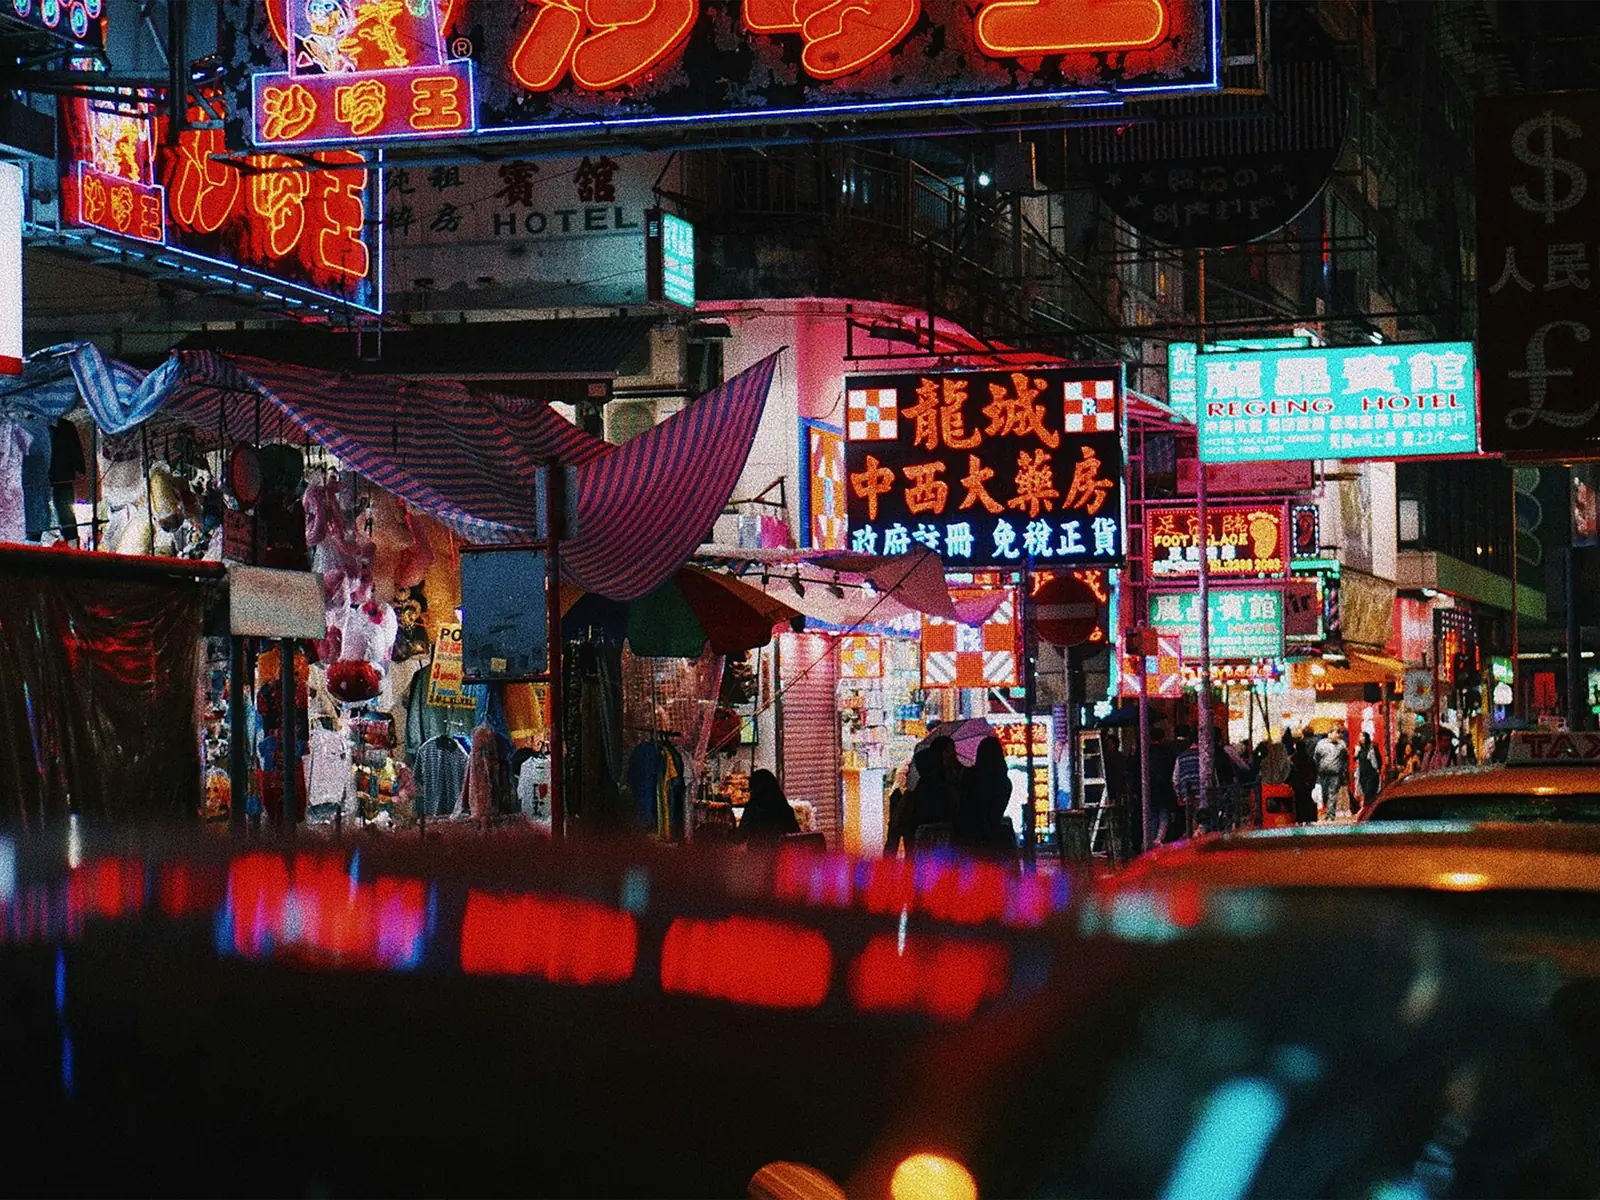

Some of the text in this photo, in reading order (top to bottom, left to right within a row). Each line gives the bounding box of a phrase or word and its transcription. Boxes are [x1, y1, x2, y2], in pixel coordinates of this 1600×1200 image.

[494, 207, 638, 239] HOTEL
[1489, 243, 1600, 294] 人民
[1204, 351, 1467, 400] 麗晶賓館
[901, 372, 1061, 450] 龍城
[1207, 398, 1333, 418] REGENG
[1362, 394, 1463, 412] HOTEL
[850, 446, 1114, 522] 中西大藥房
[1153, 533, 1248, 547] FOOT PLACE
